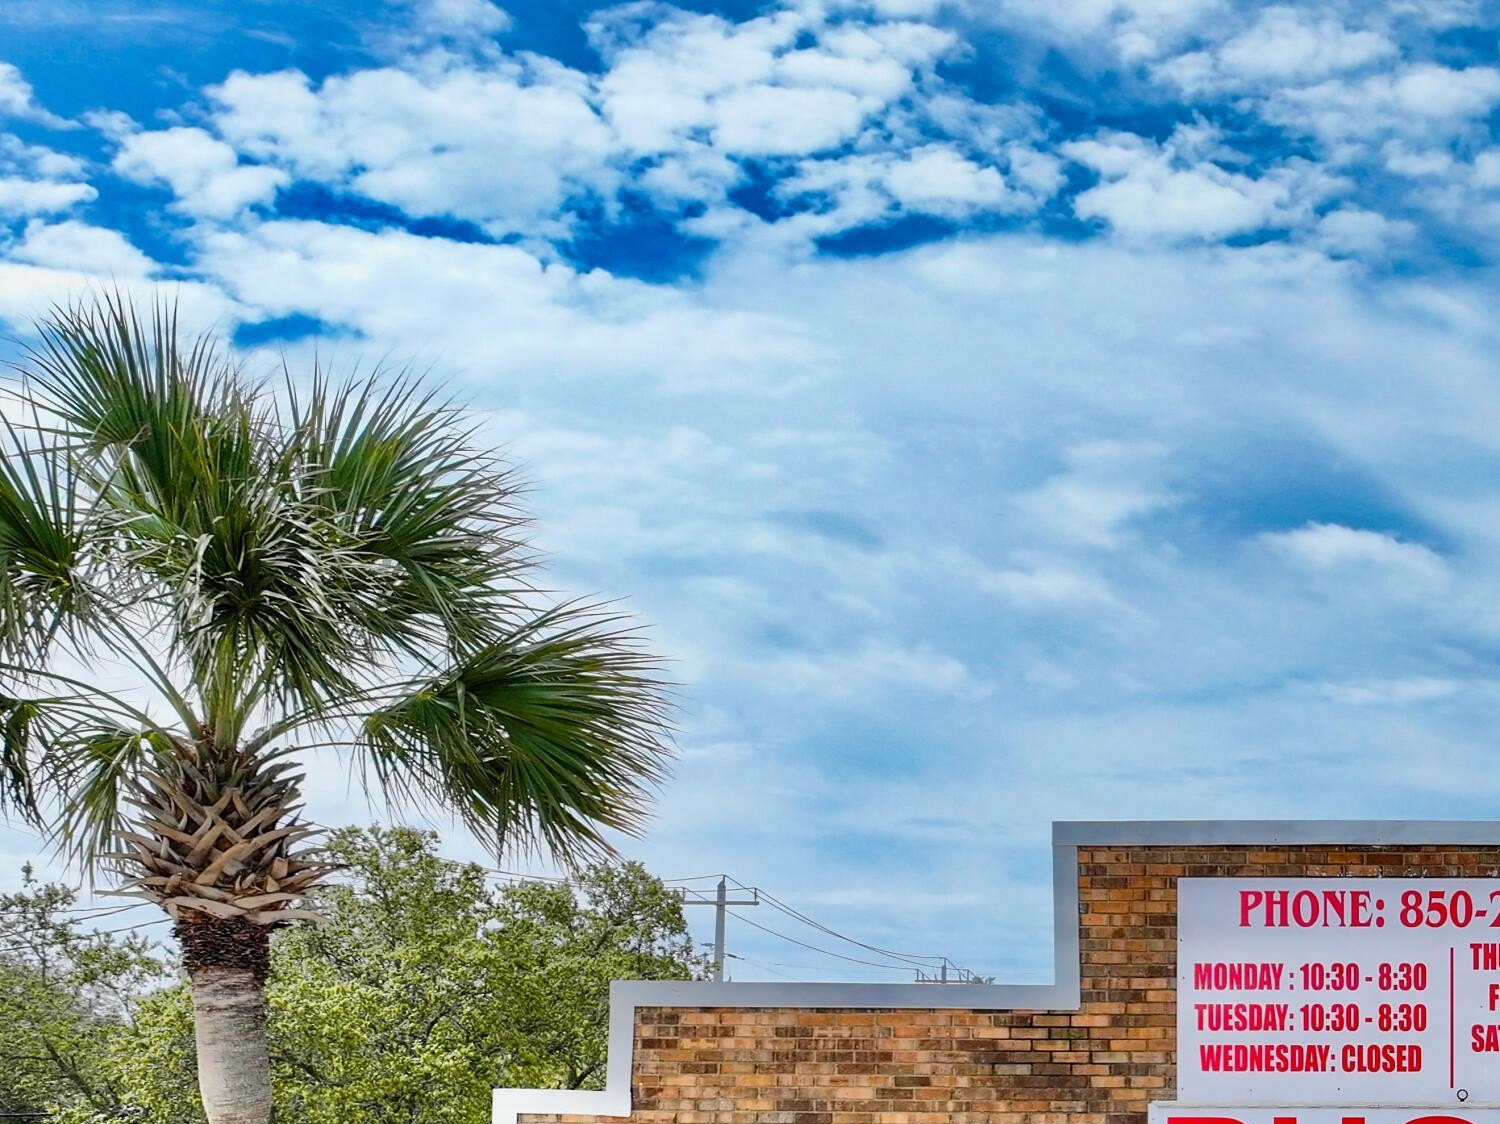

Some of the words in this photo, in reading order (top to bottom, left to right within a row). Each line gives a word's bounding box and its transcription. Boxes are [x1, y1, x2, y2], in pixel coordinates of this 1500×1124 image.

[1239, 889, 1385, 928] PHONE:
[1300, 961, 1361, 992] 10:30
[1377, 962, 1428, 992] 8:30
[1194, 1002, 1295, 1033] TUESDAY:
[1299, 1003, 1361, 1033] 10:30
[1377, 1002, 1428, 1033] 8:30
[1199, 1043, 1336, 1073] WEDNESDAY:
[1340, 1043, 1423, 1073] CLOSED
